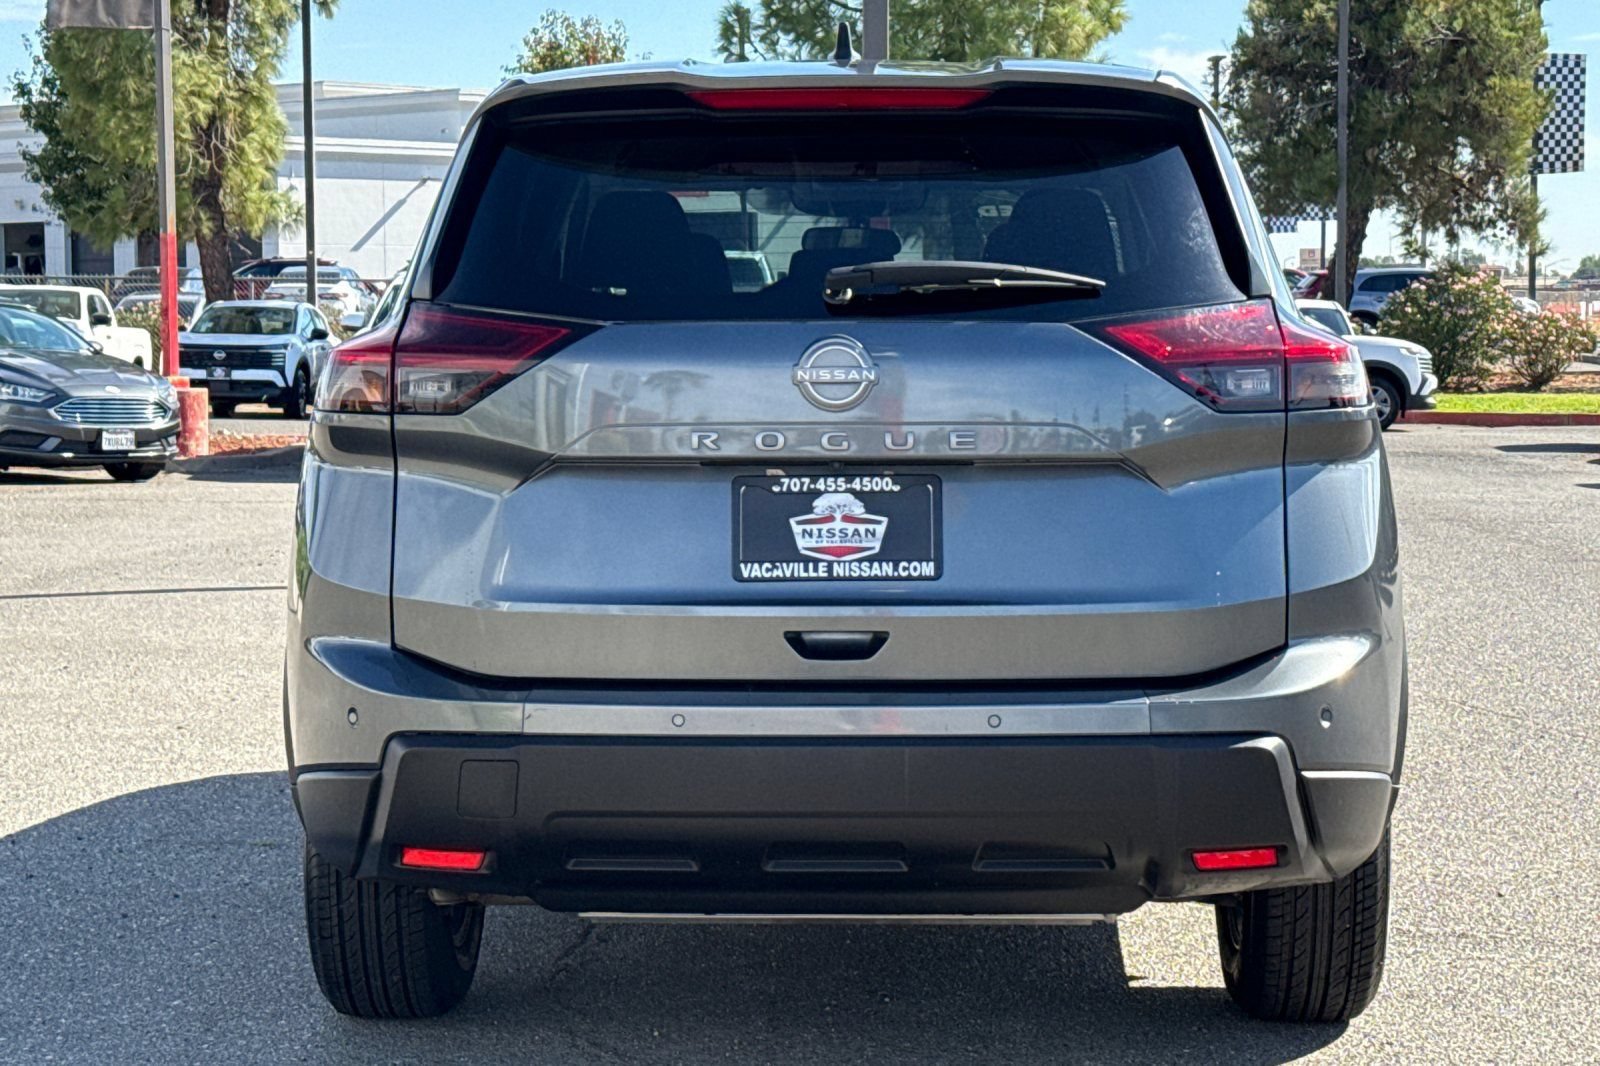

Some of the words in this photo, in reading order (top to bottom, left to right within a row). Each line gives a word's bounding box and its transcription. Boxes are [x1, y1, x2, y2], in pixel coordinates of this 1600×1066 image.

[797, 369, 876, 382] NISSAN
[690, 430, 977, 451] ROGUE
[779, 477, 893, 492] 707-455-4500
[801, 527, 877, 539] NISSAN
[739, 562, 829, 578] VACAVILLE
[832, 561, 935, 577] NISSAN.COM
